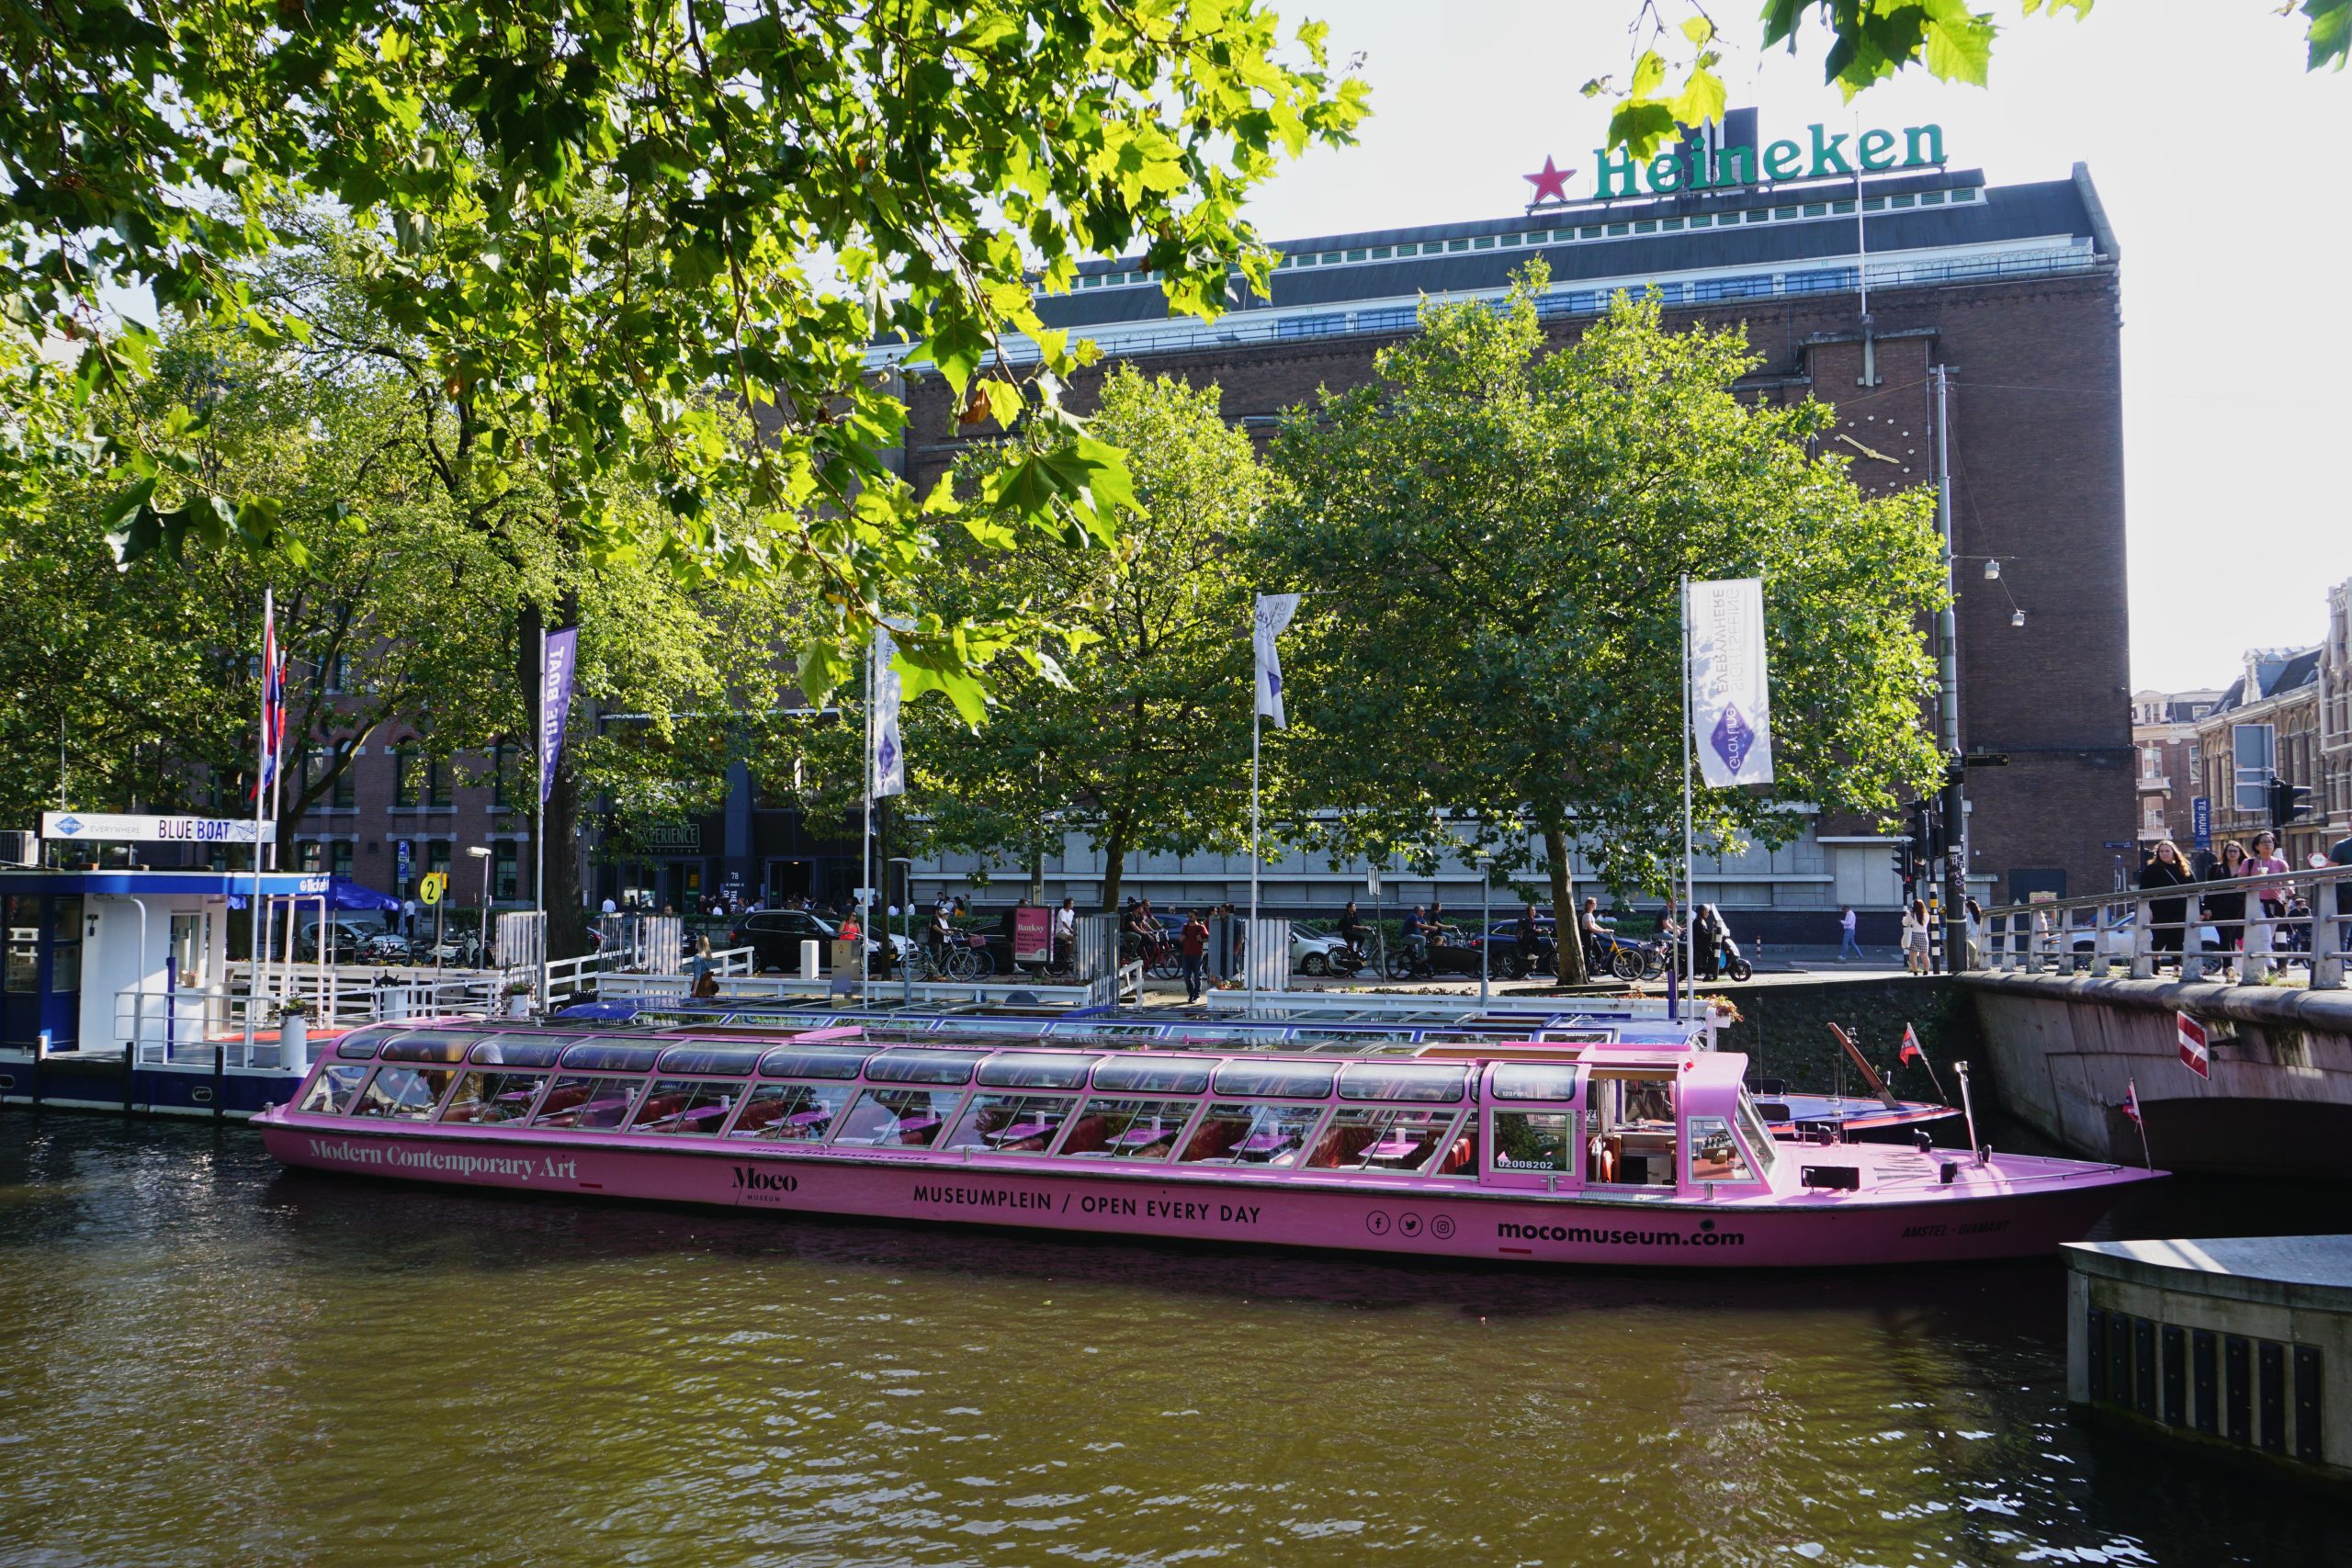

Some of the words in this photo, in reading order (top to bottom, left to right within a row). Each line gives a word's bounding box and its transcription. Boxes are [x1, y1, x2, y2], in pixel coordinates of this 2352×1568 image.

[1593, 123, 1949, 198] Heineken
[2198, 801, 2207, 811] TE
[90, 825, 141, 834] EVERYWHERE
[159, 819, 192, 839] BLUE
[197, 821, 230, 840] BOAT
[2199, 813, 2207, 836] HUUR
[400, 863, 406, 872] P
[730, 872, 739, 880] 78
[426, 880, 435, 900] 2
[309, 1139, 382, 1164] Modern
[387, 1146, 537, 1180] Contemporary
[538, 1156, 577, 1179] Art
[750, 1147, 929, 1161] mocomuseum.com
[1498, 1159, 1554, 1169] 02008202
[731, 1167, 797, 1192] Moco
[747, 1194, 780, 1202] MUSEUM
[914, 1185, 1051, 1210] MUSEUMPLEIN
[1081, 1196, 1136, 1216] OPEN
[1148, 1200, 1209, 1220] EVERY
[1220, 1205, 1261, 1224] DAY
[1498, 1221, 1744, 1246] mocomuseum.com
[1902, 1225, 1948, 1239] AMSTEL
